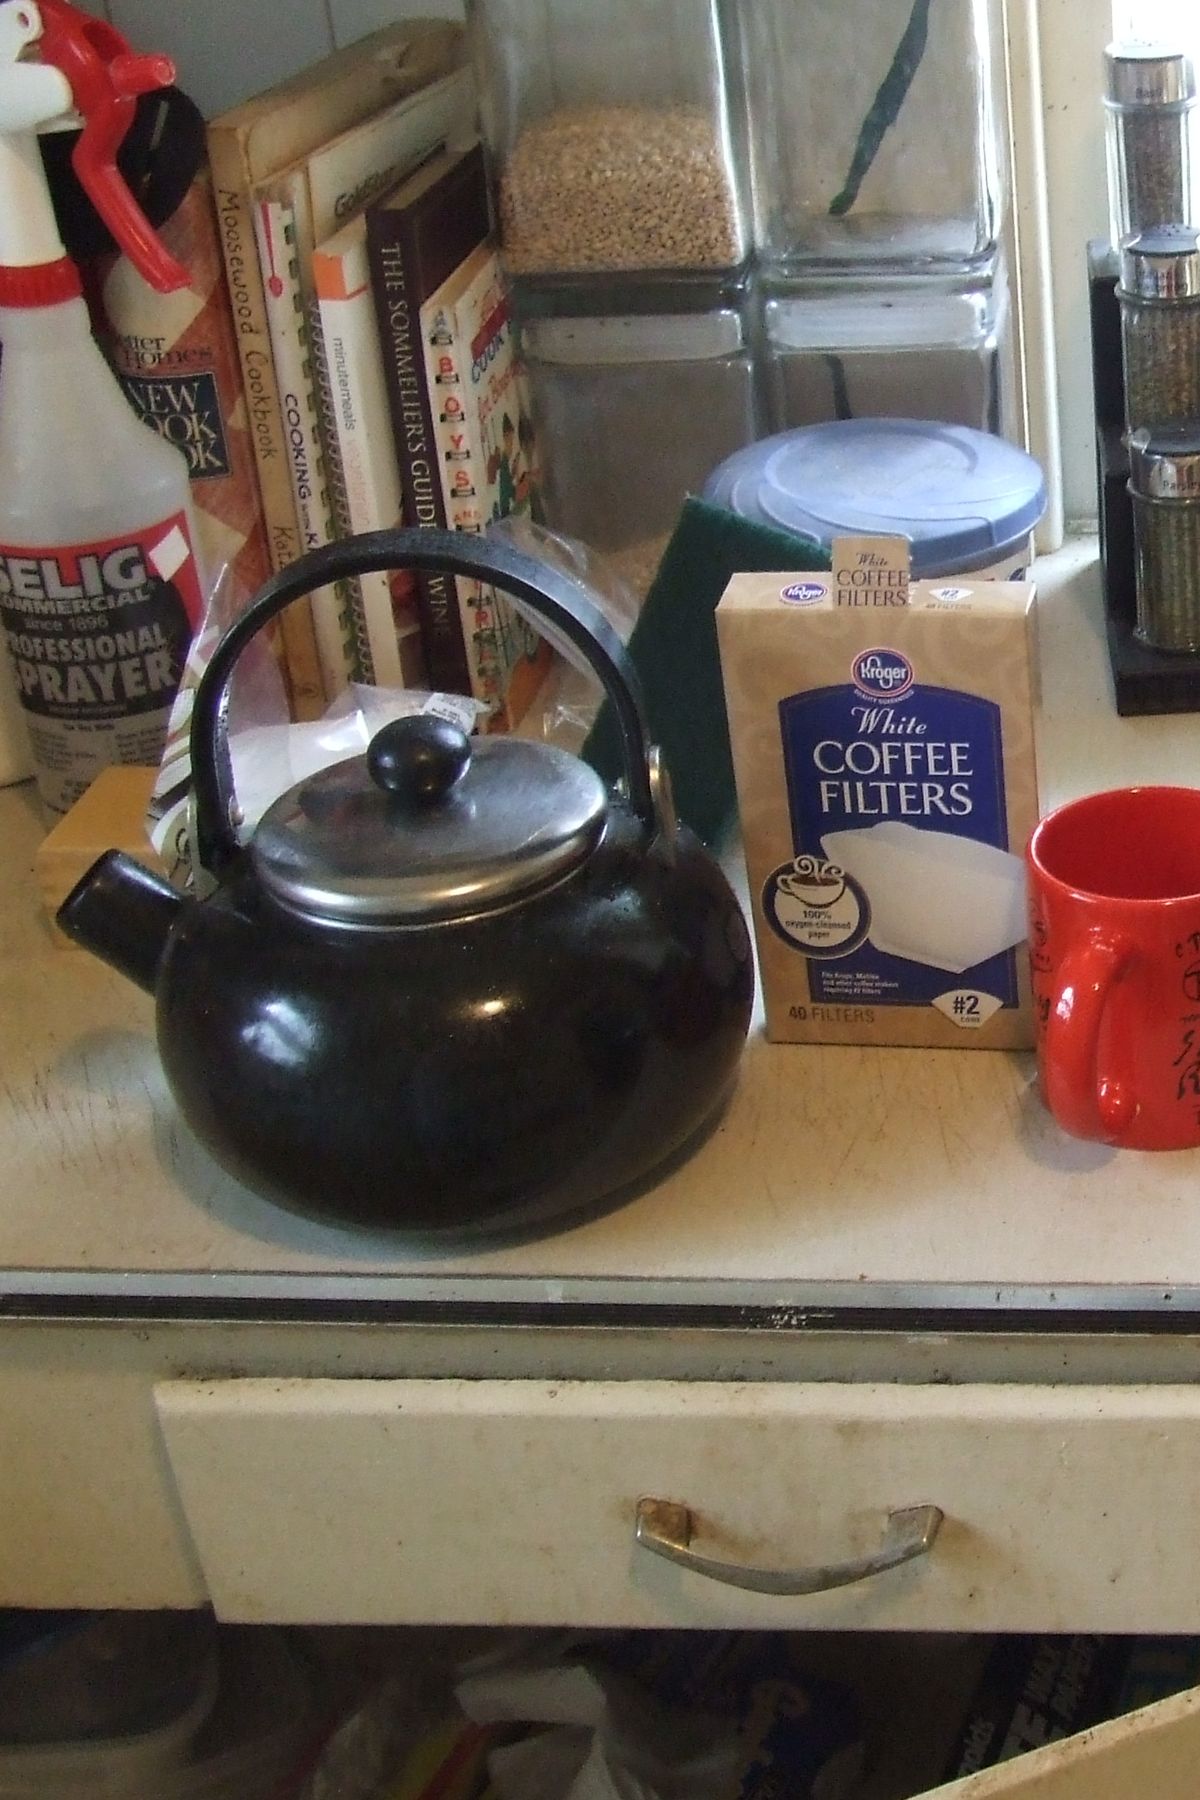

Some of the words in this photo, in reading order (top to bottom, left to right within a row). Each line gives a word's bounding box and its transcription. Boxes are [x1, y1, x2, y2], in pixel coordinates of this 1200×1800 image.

[380, 243, 405, 290] THE
[218, 188, 260, 335] Moosewood
[245, 350, 277, 461] Cookbook
[387, 299, 426, 453] SOMMELIER'S
[284, 393, 312, 500] COOKING
[855, 552, 889, 567] White
[786, 585, 823, 600] Kroger
[836, 569, 909, 588] COFFEE
[837, 589, 907, 607] FILTERS
[11, 622, 168, 662] ROFESSIONAL
[860, 656, 908, 690] Kroger
[851, 705, 928, 735] White
[813, 740, 974, 777] COFFEE
[819, 780, 974, 816] FILTERS
[803, 910, 832, 920] 100%
[808, 931, 830, 940] paper
[788, 1006, 807, 1020] 40
[811, 1007, 876, 1024] FILTERS
[952, 995, 980, 1015] #2
